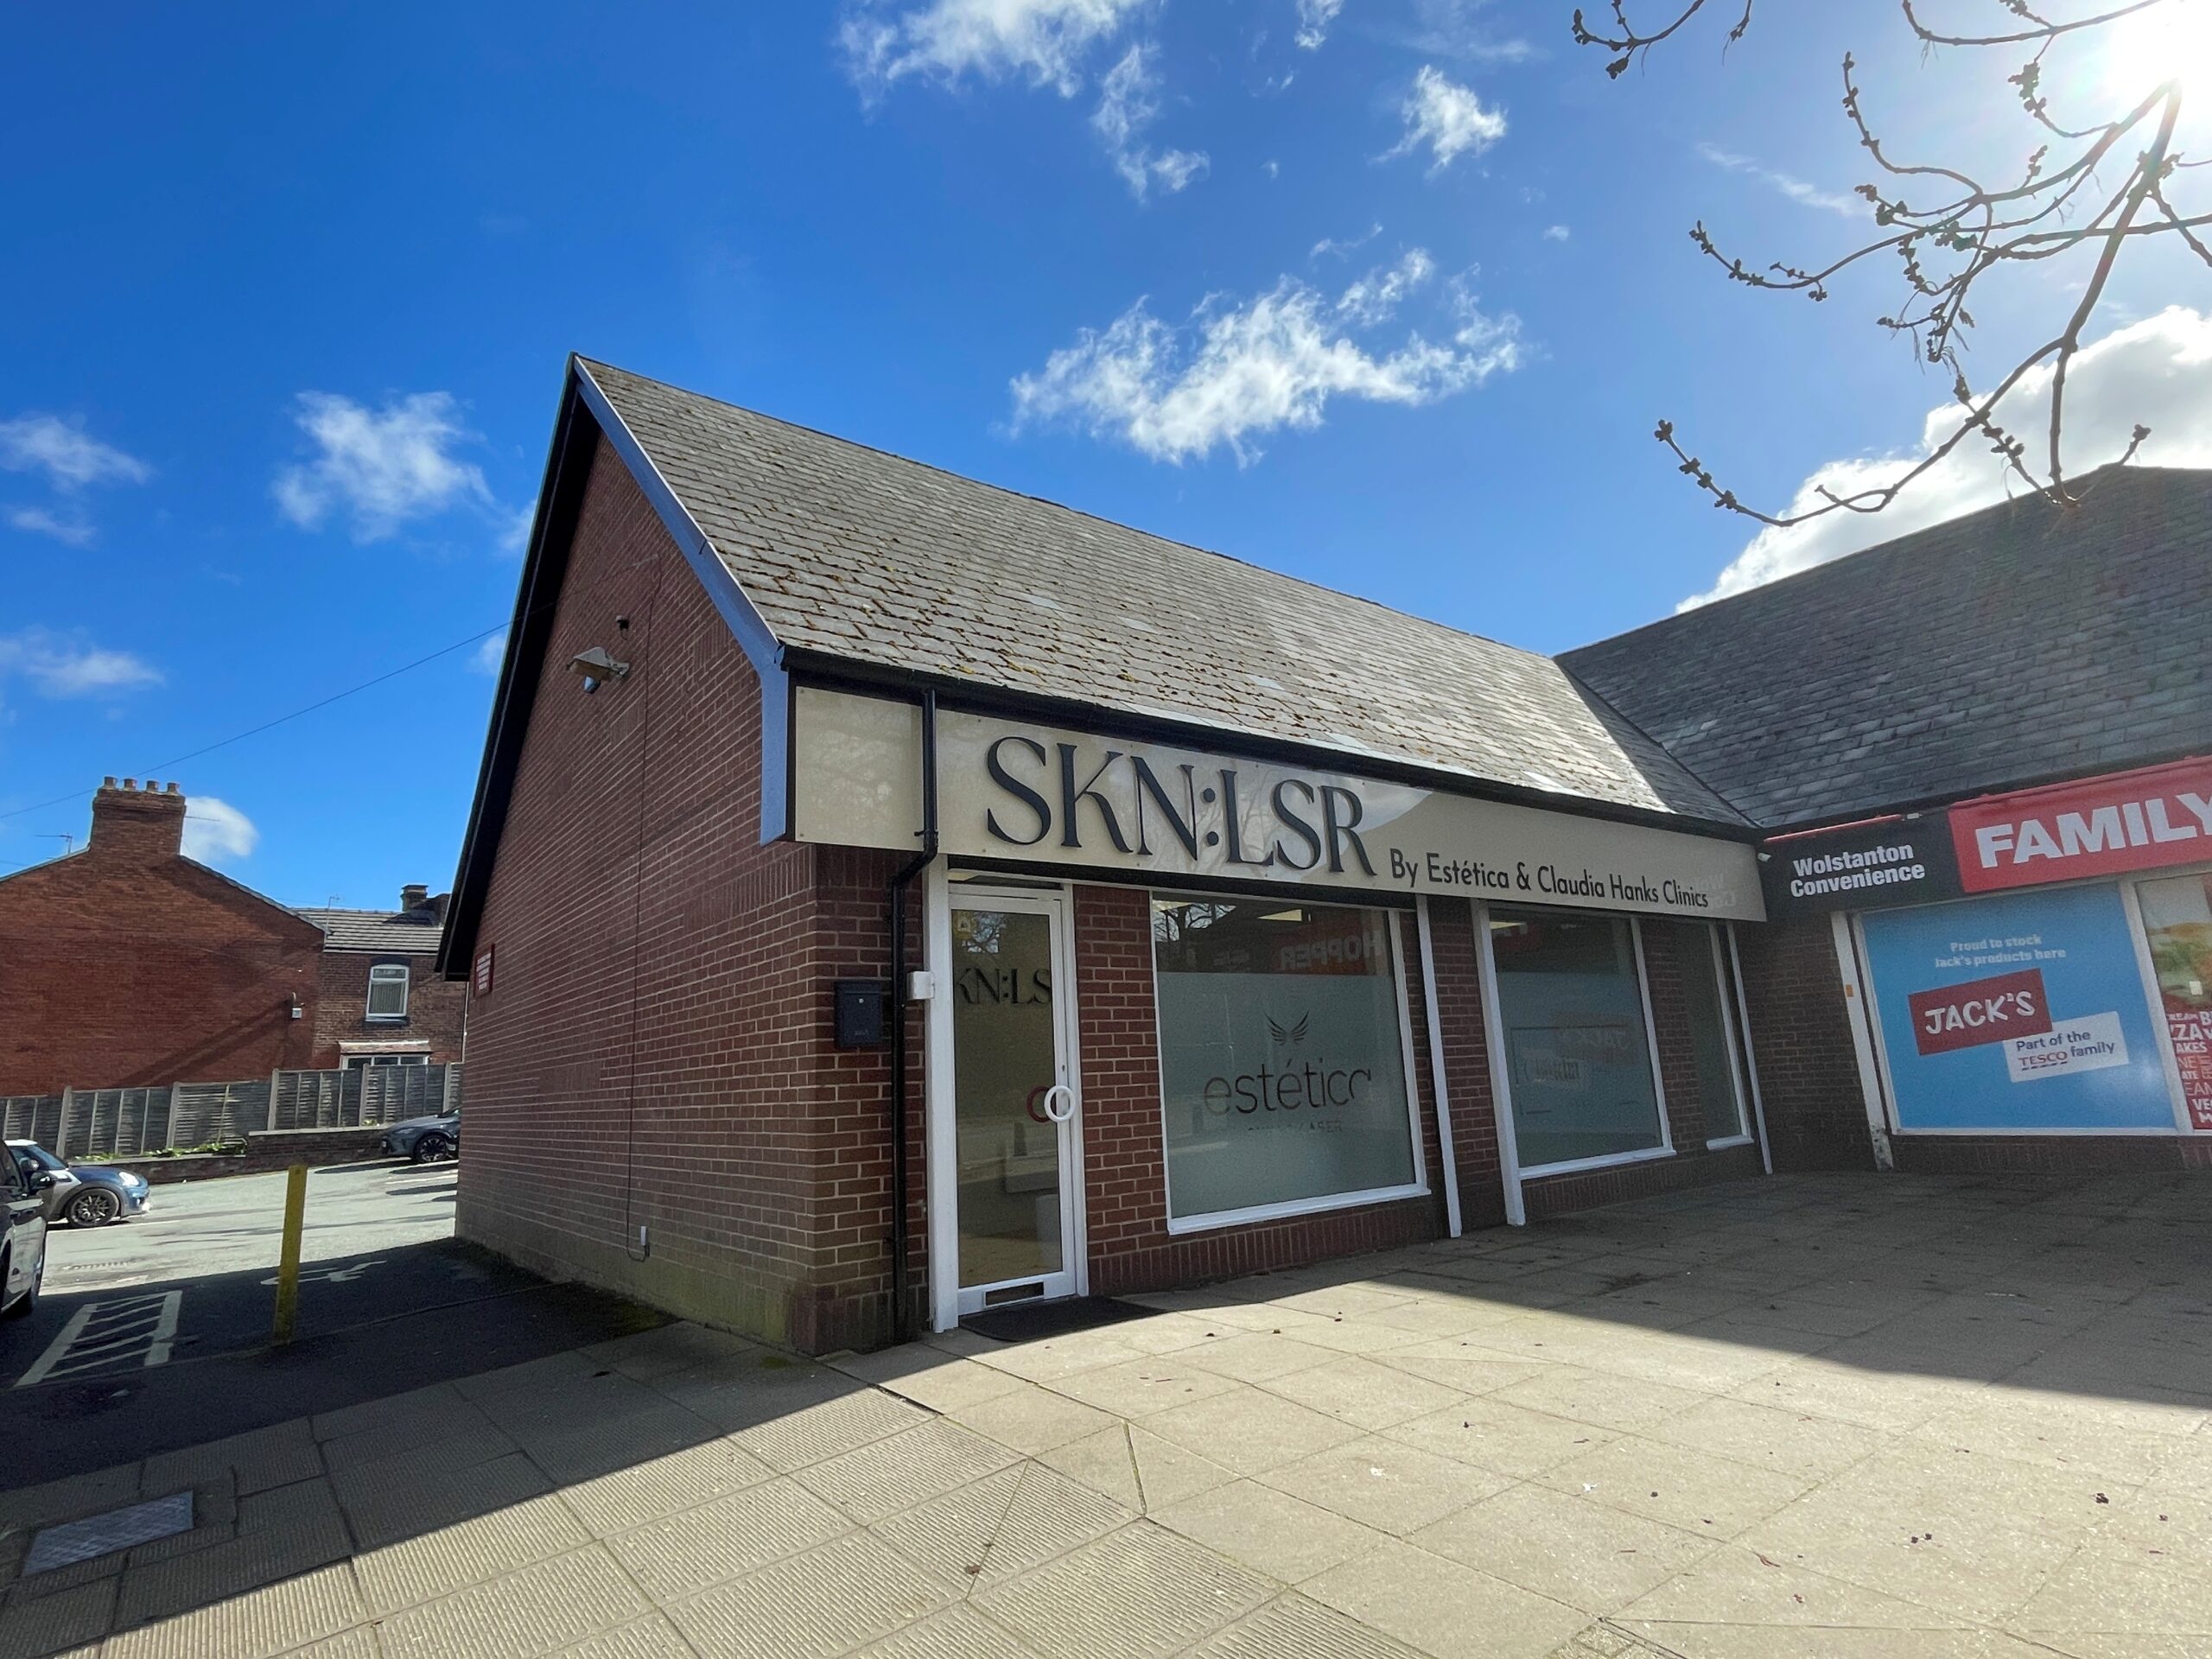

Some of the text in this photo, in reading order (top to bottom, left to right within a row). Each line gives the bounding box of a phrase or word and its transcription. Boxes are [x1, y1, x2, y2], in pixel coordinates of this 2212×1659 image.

[1975, 792, 2212, 868] FAMILY
[1793, 844, 1914, 876] Wolstanton
[1389, 848, 1418, 887] By
[1427, 852, 1510, 889] Estética
[1516, 861, 1531, 891] &
[1538, 865, 1605, 897] Claudia
[1610, 874, 1659, 902] Hanks
[1663, 879, 1709, 907] Clinics
[1789, 864, 1925, 897] Convenience
[1936, 949, 2066, 968] Jack's products here
[1950, 934, 2042, 951] Proud to stock
[1924, 990, 2036, 1034] JACK'S
[2016, 1030, 2091, 1052] Part of the
[2018, 1042, 2115, 1066] TESCO family
